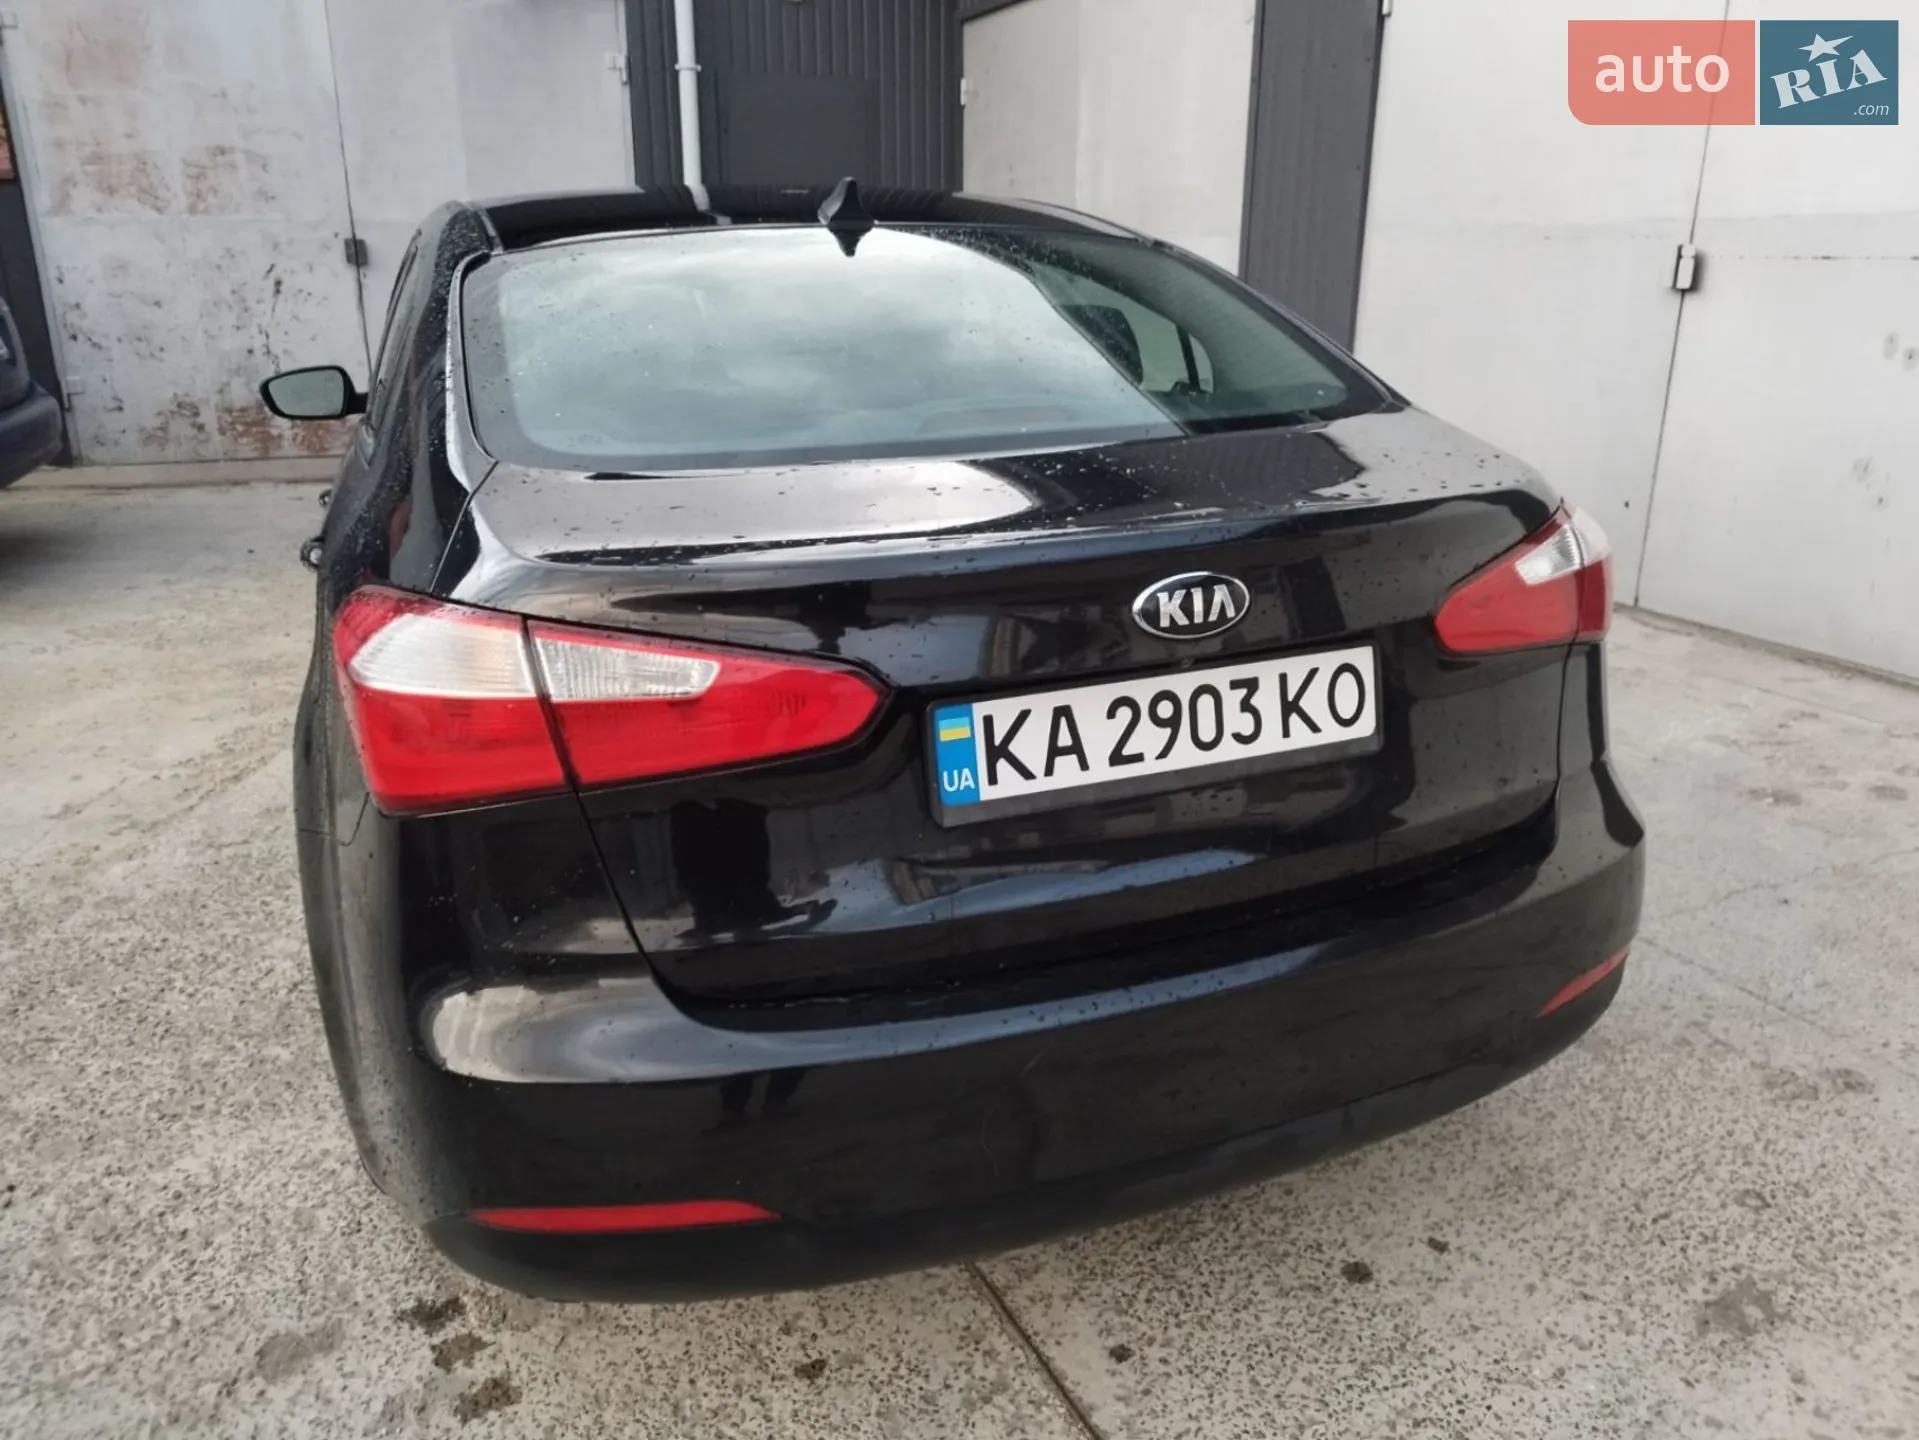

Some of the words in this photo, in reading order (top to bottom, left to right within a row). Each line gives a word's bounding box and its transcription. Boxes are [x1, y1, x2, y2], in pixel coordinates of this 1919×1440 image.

[1157, 584, 1237, 628] KIA
[982, 704, 1091, 786] KA
[1106, 676, 1263, 767] 2903
[1278, 662, 1366, 739] KO
[942, 768, 976, 792] UA
